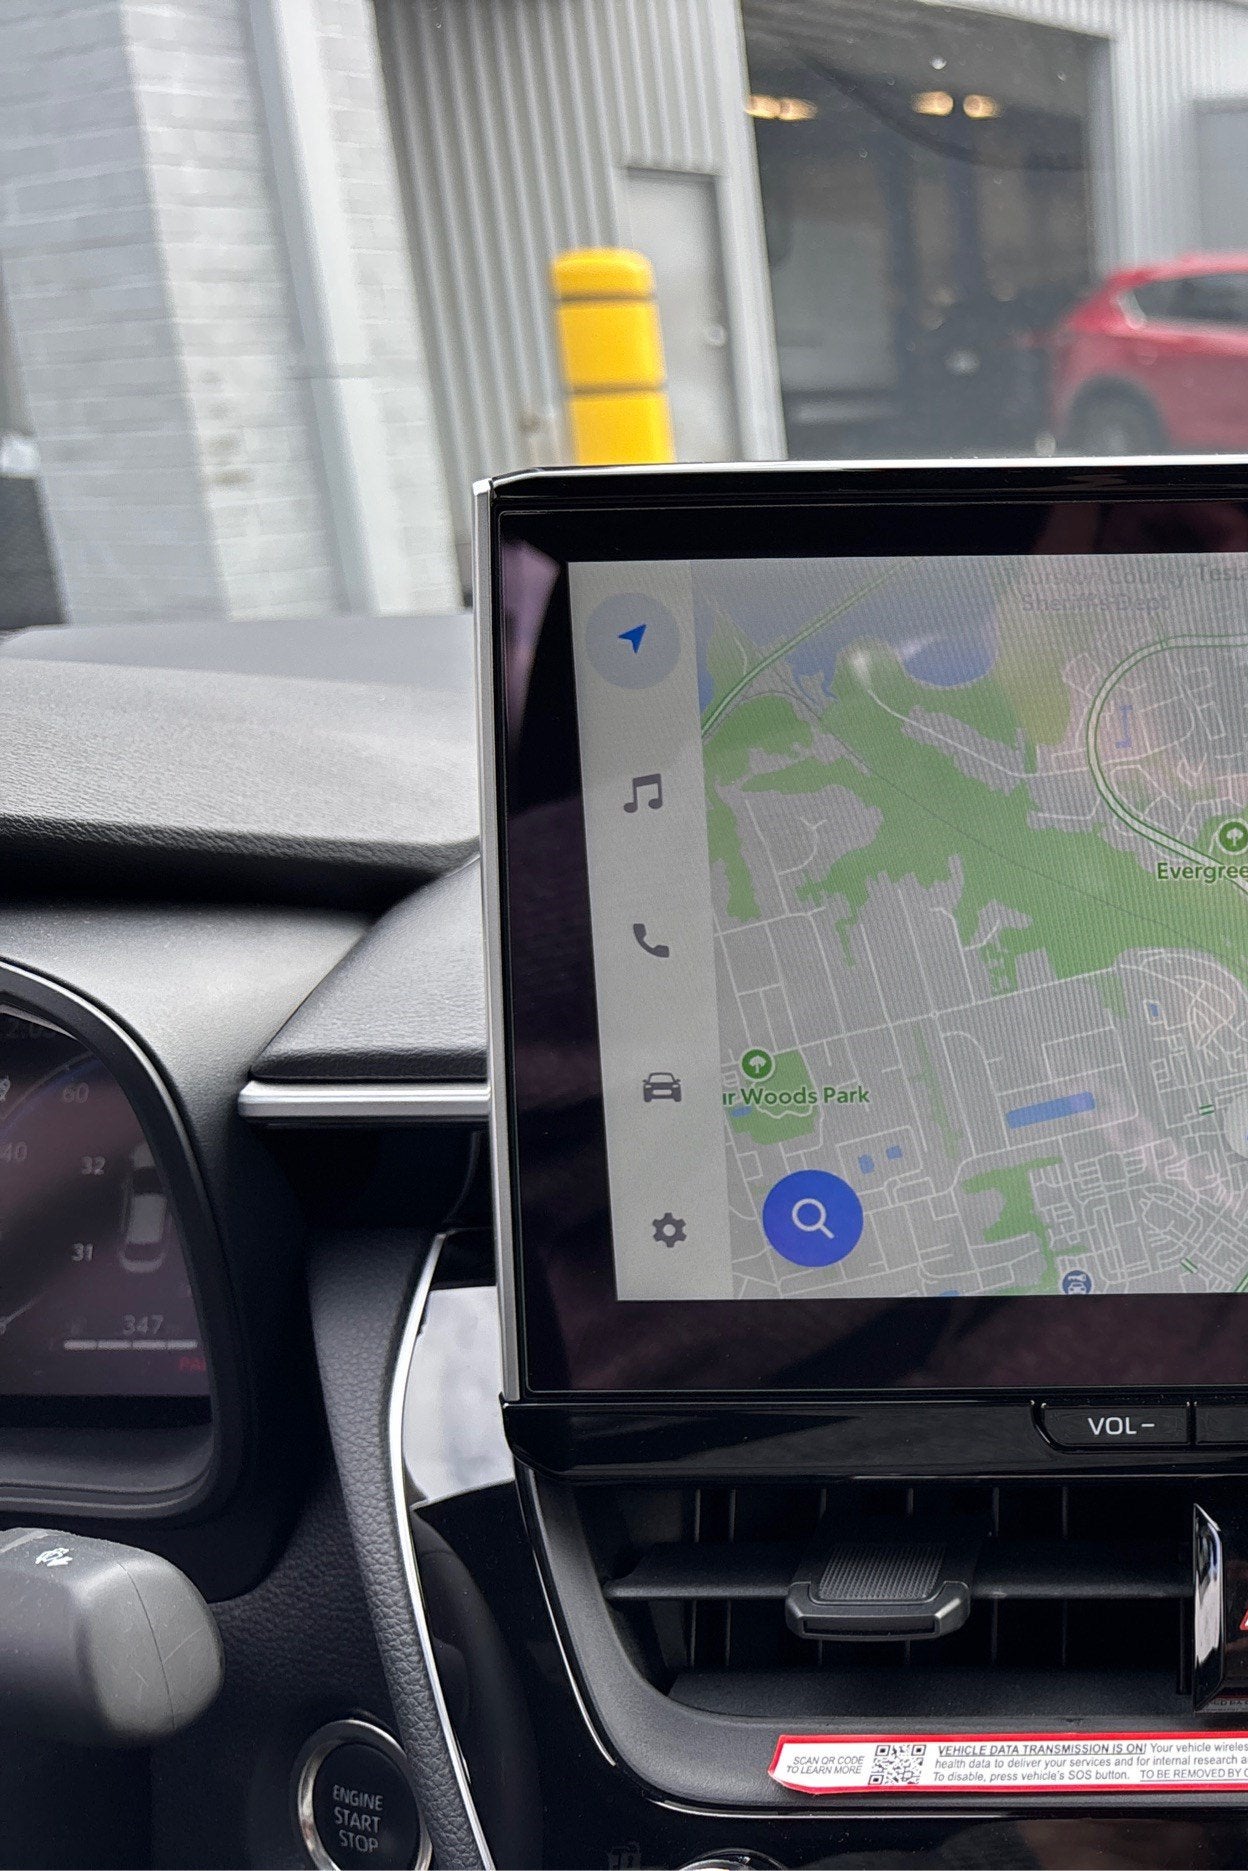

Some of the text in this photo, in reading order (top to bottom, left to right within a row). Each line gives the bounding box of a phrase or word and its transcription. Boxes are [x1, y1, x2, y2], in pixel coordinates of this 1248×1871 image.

[740, 1086, 818, 1105] Woods
[823, 1085, 870, 1104] Park
[81, 1156, 107, 1176] 32
[70, 1242, 95, 1262] 31
[122, 1314, 164, 1336] 347
[938, 1745, 988, 1756] VEHICLE
[989, 1744, 1020, 1755] DATA
[1022, 1743, 1110, 1755] TRANSMISSION
[1112, 1743, 1123, 1754] IS
[1150, 1742, 1174, 1753] Your
[1176, 1741, 1212, 1752] vehicle
[786, 1765, 863, 1775] TO LEARN MORE
[793, 1756, 820, 1766] SCAN
[837, 1756, 865, 1765] CODE
[935, 1758, 966, 1769] health
[968, 1758, 991, 1769] data
[994, 1758, 1005, 1769] to
[1007, 1757, 1042, 1768] deliver
[1044, 1759, 1067, 1770] your
[1069, 1757, 1111, 1768] services
[1114, 1756, 1134, 1767] and
[1136, 1755, 1151, 1766] for
[1153, 1755, 1191, 1766] internal
[1193, 1754, 1238, 1765] research
[933, 1771, 945, 1782] To
[947, 1771, 987, 1783] disable,
[989, 1772, 1018, 1783] press
[1021, 1770, 1065, 1781] vehicle's
[1068, 1769, 1092, 1781] SOS
[1095, 1769, 1130, 1780] button.
[1140, 1769, 1155, 1779] TO
[1157, 1769, 1171, 1779] BE
[1173, 1768, 1226, 1779] REMOVED
[1228, 1767, 1242, 1778] BY
[332, 1784, 384, 1812] ENGINE
[333, 1806, 381, 1834] START
[338, 1829, 379, 1853] STOP
